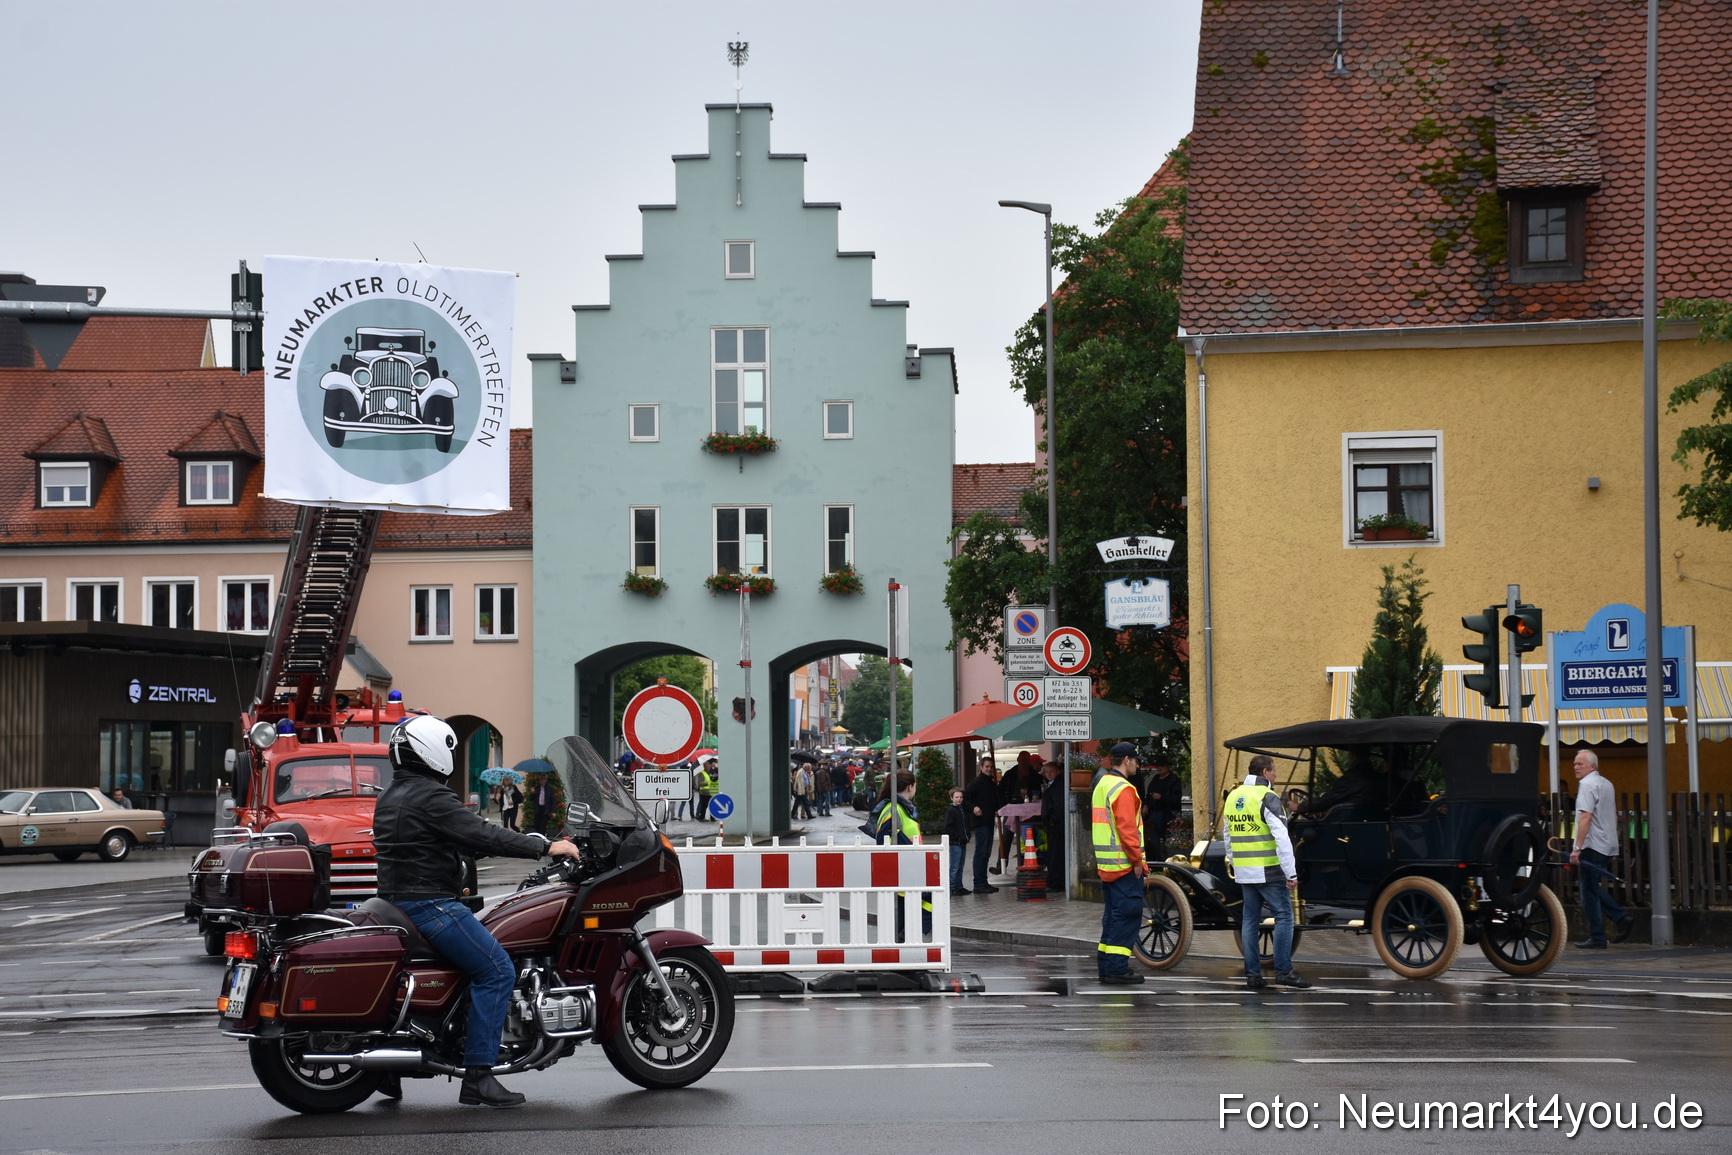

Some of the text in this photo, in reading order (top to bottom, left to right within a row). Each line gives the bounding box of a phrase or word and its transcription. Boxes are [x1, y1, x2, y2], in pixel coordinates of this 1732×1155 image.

[273, 276, 504, 447] NEUMARKTER OLDTIMERTREFFEN
[1105, 545, 1168, 559] Ganskeller
[1110, 595, 1164, 604] GANSBRÄU
[1112, 613, 1132, 622] guter
[1568, 665, 1672, 680] BIERGARTN
[148, 686, 216, 703] ZENTRAL
[1018, 688, 1034, 701] 30
[1568, 686, 1610, 695] UNTERER
[1058, 694, 1078, 702] Anlieger
[1047, 701, 1077, 709] Rathausplatz
[1077, 728, 1088, 736] frei
[645, 775, 680, 783] Oldtimer
[656, 787, 670, 795] frei
